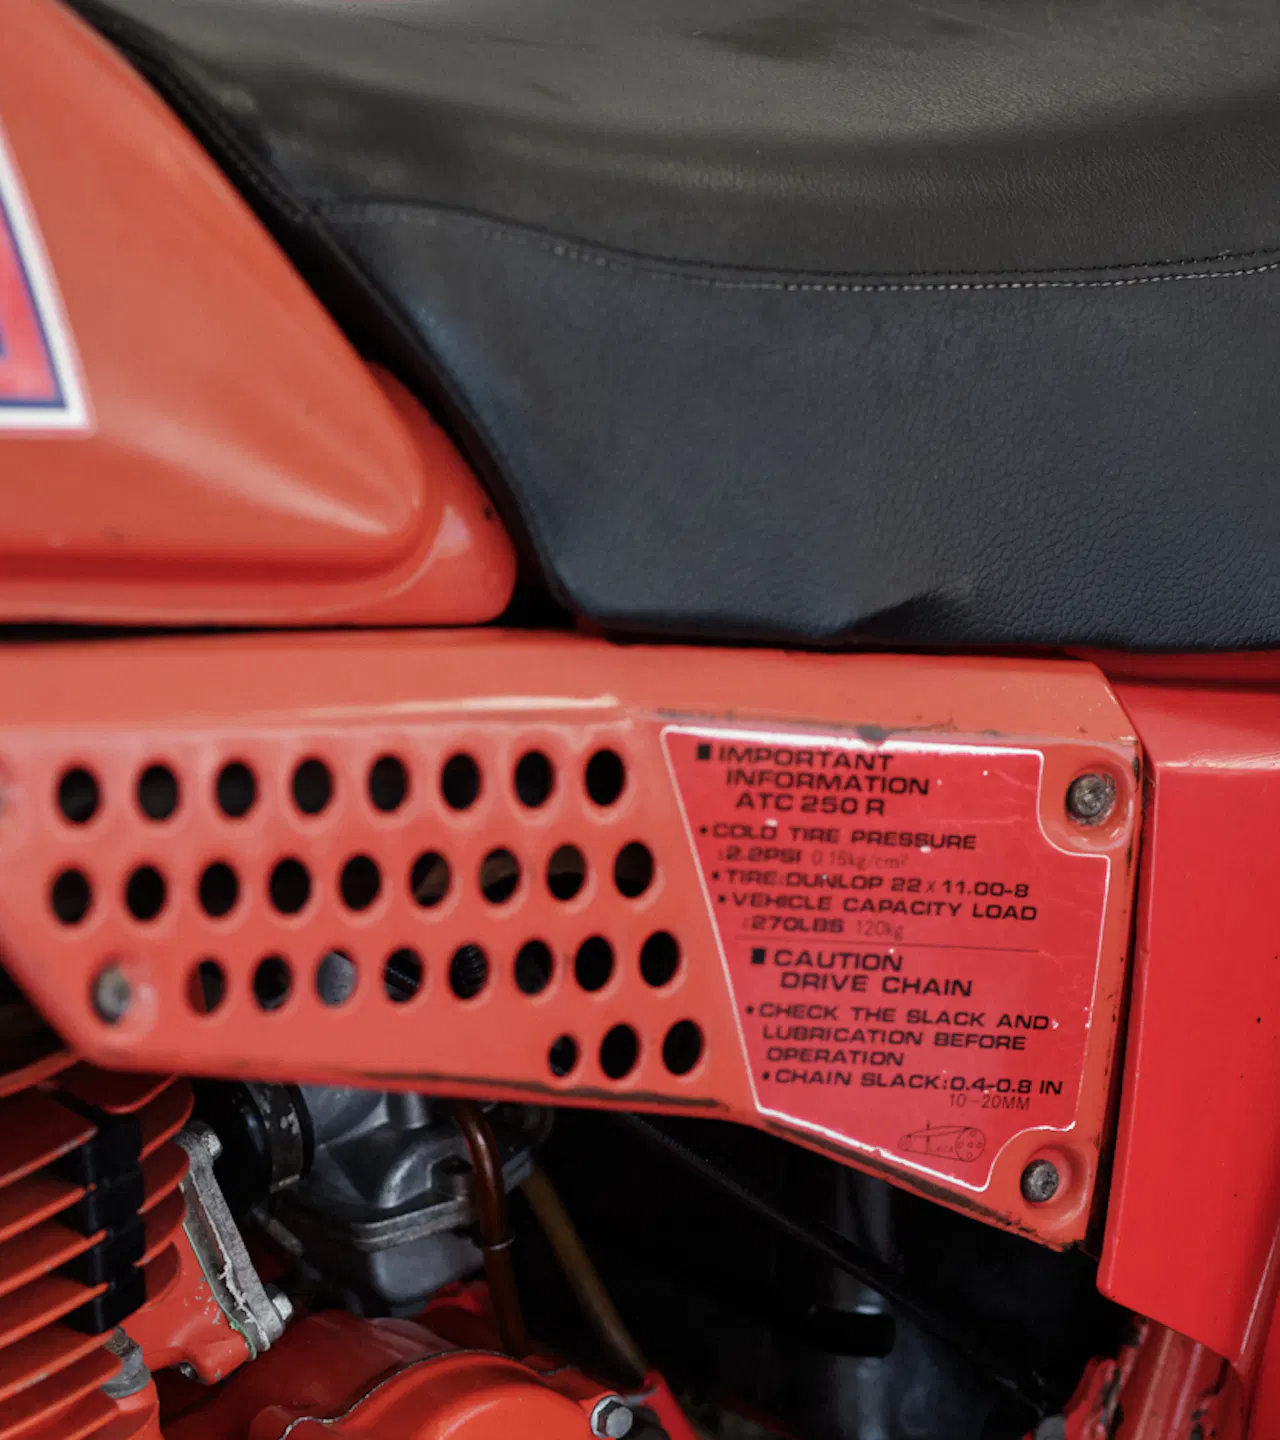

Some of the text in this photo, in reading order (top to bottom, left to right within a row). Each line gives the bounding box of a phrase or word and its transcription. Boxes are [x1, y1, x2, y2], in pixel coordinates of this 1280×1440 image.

[719, 747, 893, 770] IMPORTANT
[726, 769, 929, 795] INFORMATION
[736, 792, 885, 815] ATC 250 R
[713, 824, 976, 850] COLD TIRE PRESSURE
[891, 877, 920, 892] 22
[942, 880, 1029, 897] 11.00-8
[733, 892, 1037, 920] VEHICLE CAPACITY LOAD
[774, 950, 902, 971] CAUTION
[780, 972, 972, 997] DRIVE CHAIN
[759, 1002, 1050, 1029] CHECK THE SLACK AND
[763, 1025, 1026, 1050] LUBRICATION BEFORE
[767, 1047, 904, 1066] OPERATION
[775, 1068, 852, 1085] CHAIN
[1040, 1080, 1063, 1095] IN
